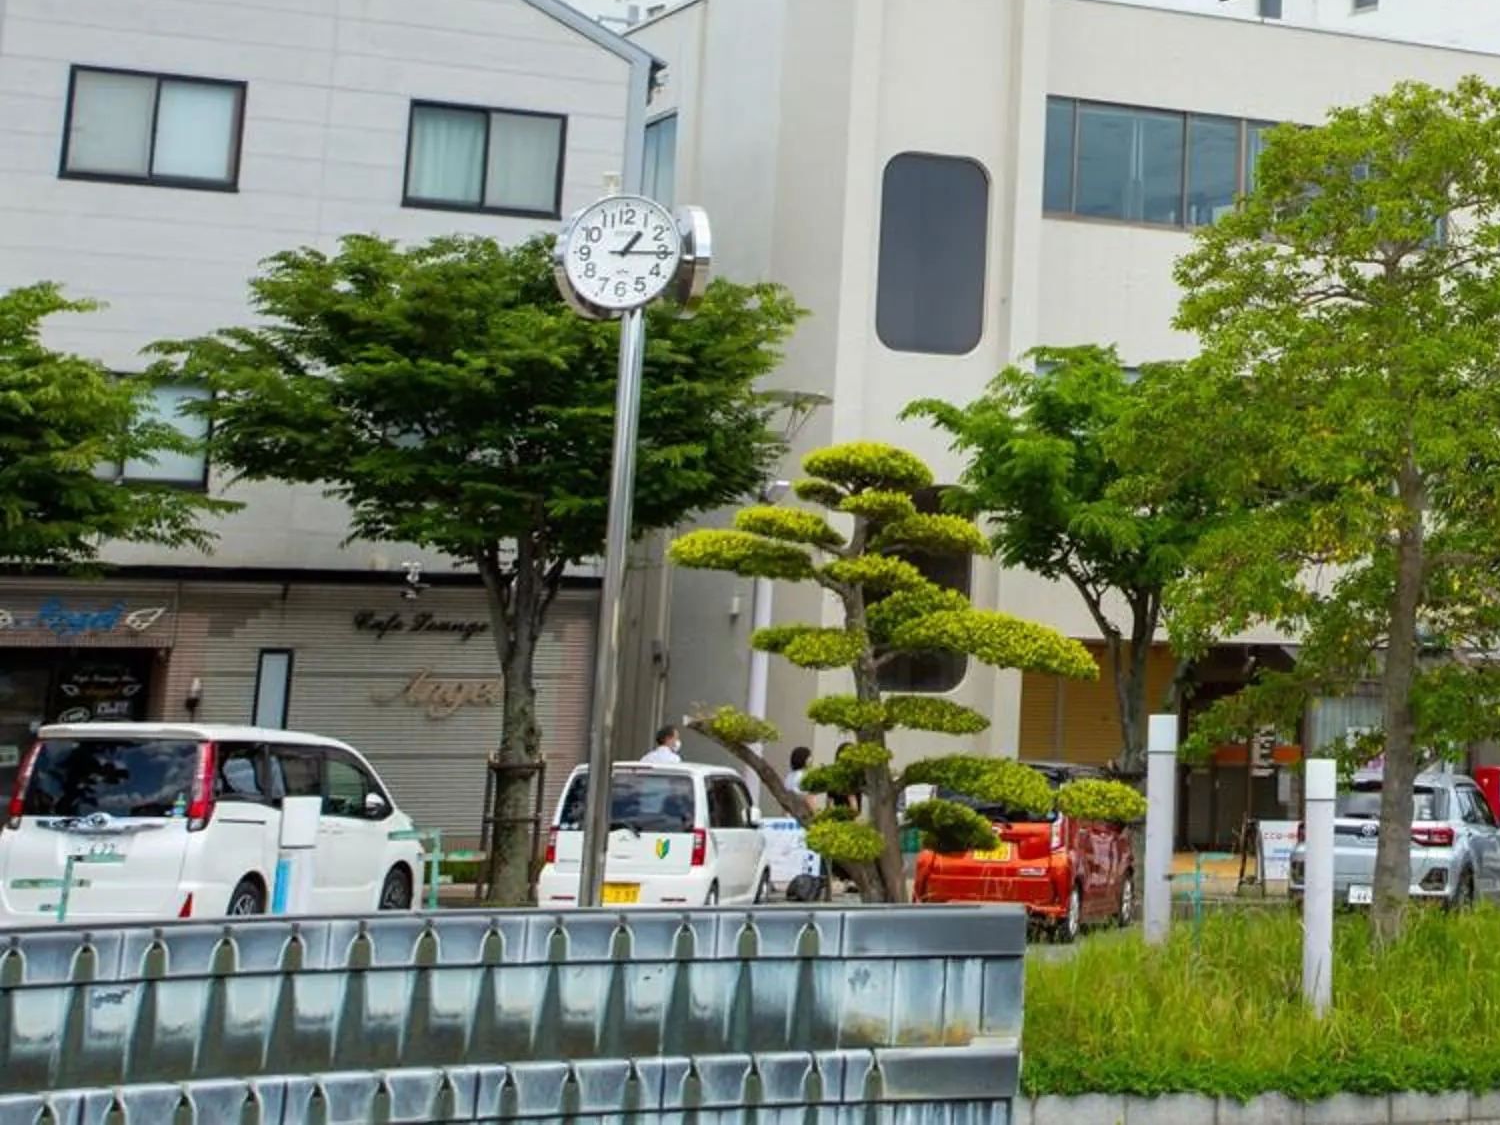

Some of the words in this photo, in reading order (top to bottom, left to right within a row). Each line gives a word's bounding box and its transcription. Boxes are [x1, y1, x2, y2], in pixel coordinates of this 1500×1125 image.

[602, 213, 615, 227] 11
[619, 208, 636, 226] 12
[582, 226, 602, 242] 10
[653, 226, 665, 241] 2
[579, 245, 591, 261] 9
[656, 244, 669, 260] 3
[584, 262, 596, 278] 8
[649, 263, 661, 278] 4
[599, 277, 610, 292] 7
[614, 281, 626, 297] 6
[634, 277, 646, 292] 5
[409, 611, 490, 641] Lounge
